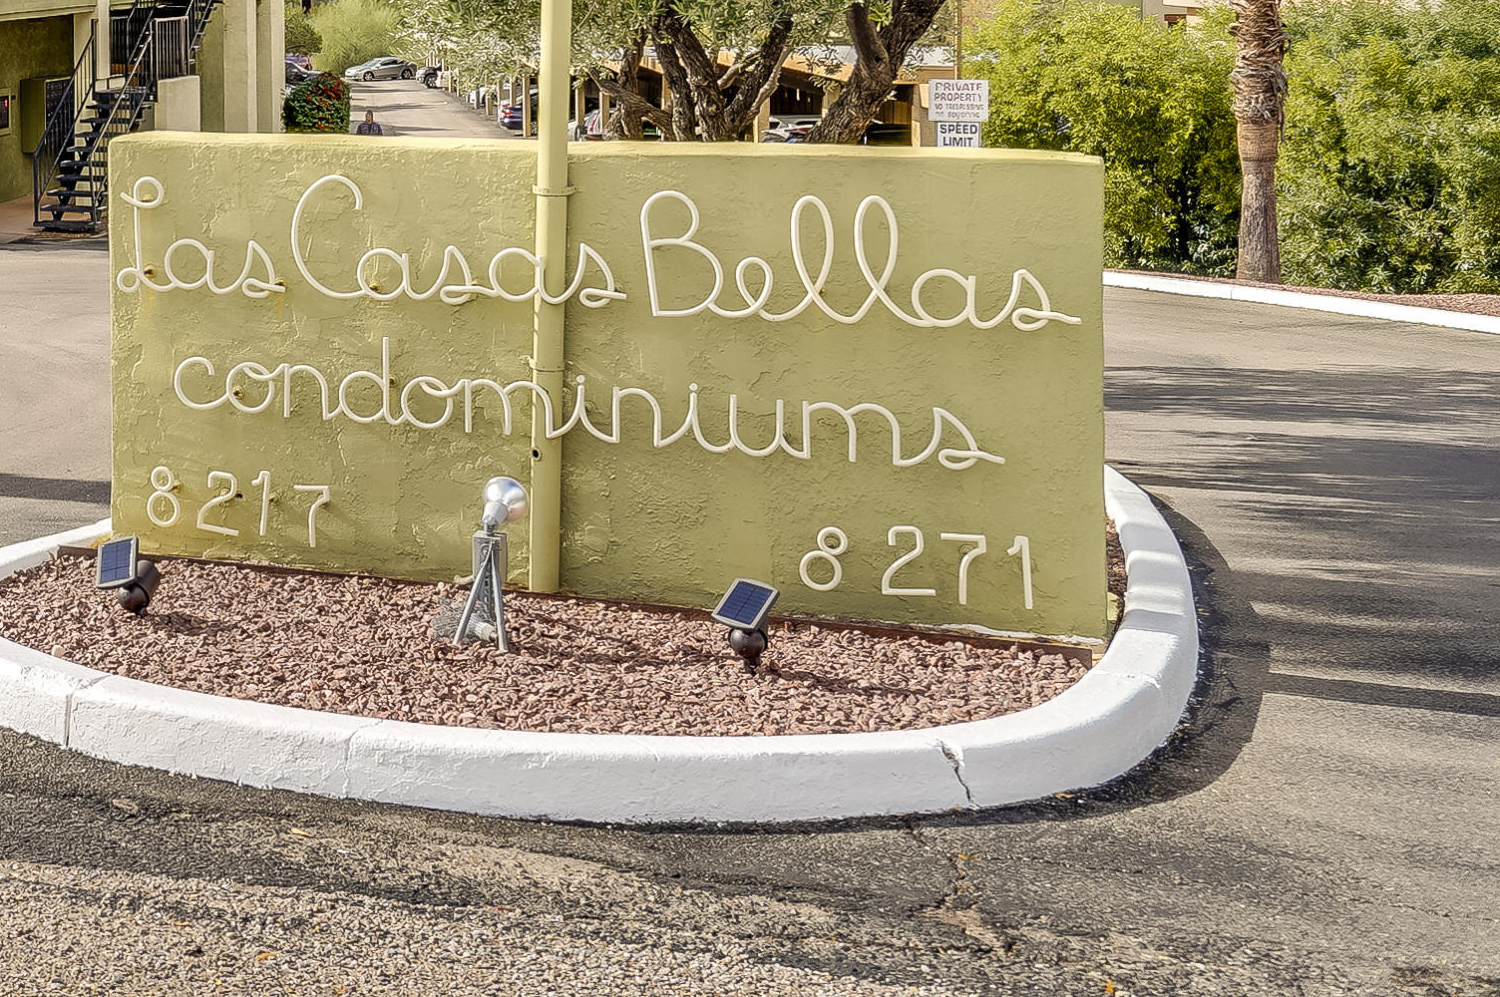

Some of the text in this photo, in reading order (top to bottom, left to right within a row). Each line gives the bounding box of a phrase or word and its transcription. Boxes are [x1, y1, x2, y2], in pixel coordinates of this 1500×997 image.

[933, 93, 982, 102] PROPERTY
[935, 82, 982, 91] PRIVATE
[940, 124, 978, 134] SPEED
[943, 136, 973, 146] LIMIT
[116, 174, 1082, 332] Las Casas Bellas
[173, 336, 1006, 471] condominiums
[146, 465, 330, 548] 8217
[799, 525, 1033, 610] 8271
